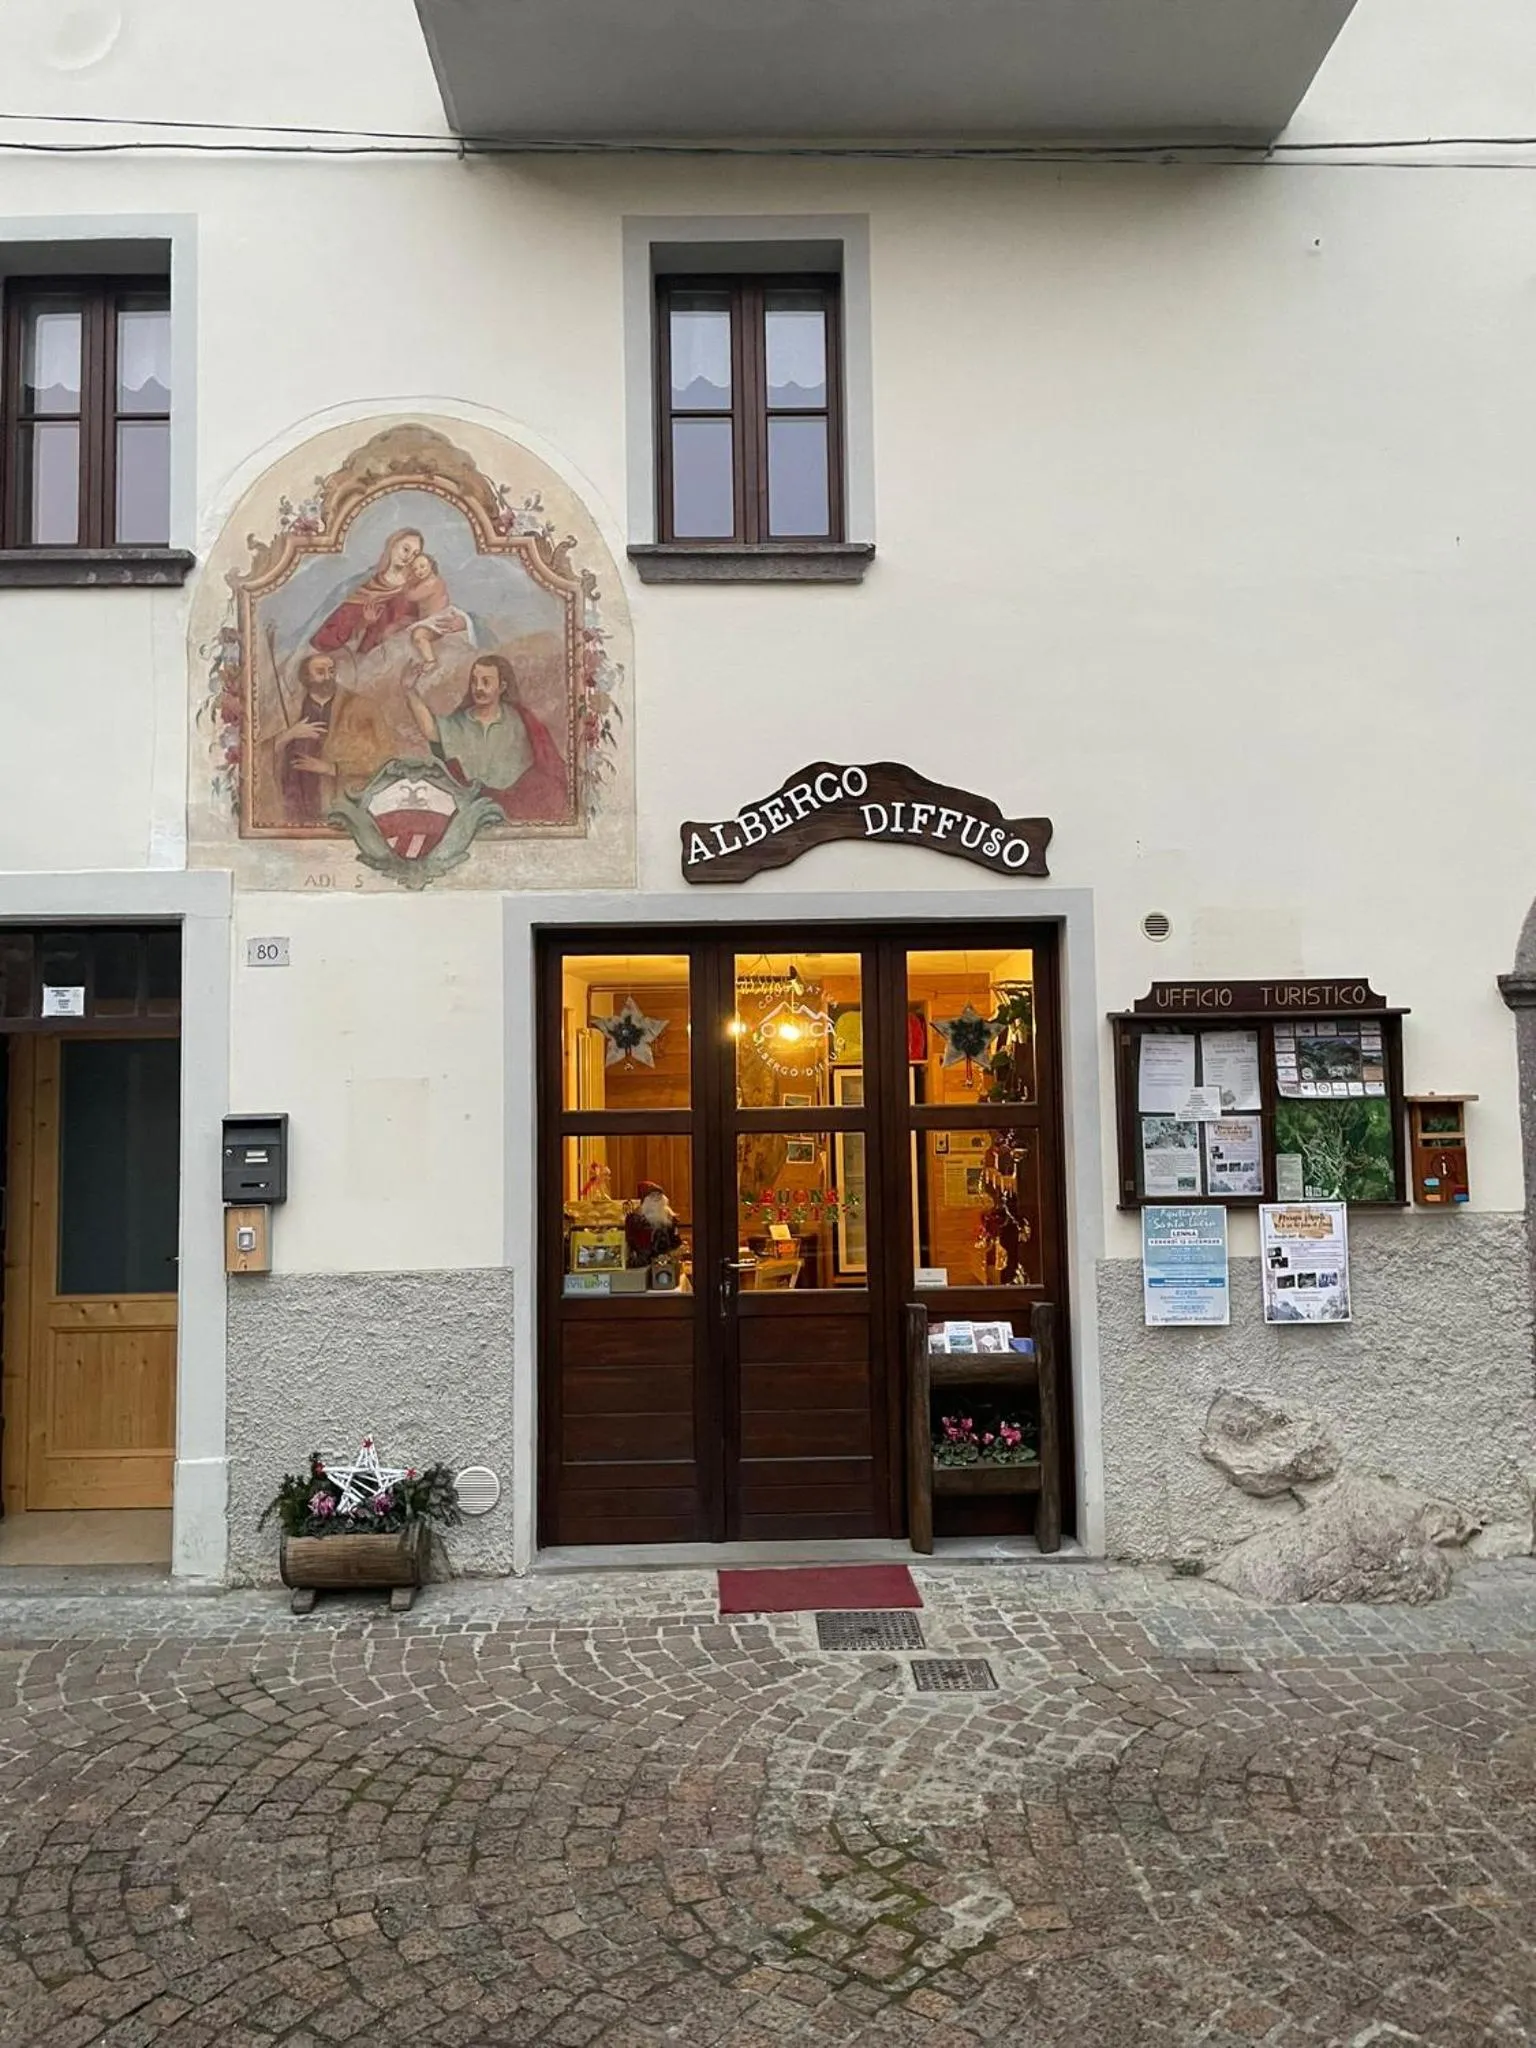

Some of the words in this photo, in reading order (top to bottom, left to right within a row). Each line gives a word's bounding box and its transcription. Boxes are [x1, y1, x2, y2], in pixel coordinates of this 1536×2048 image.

[860, 802, 1030, 868] DIFFUSO
[257, 944, 278, 959] 80
[1156, 988, 1233, 1007] UFFICIO
[1260, 985, 1366, 1006] TURISTICO
